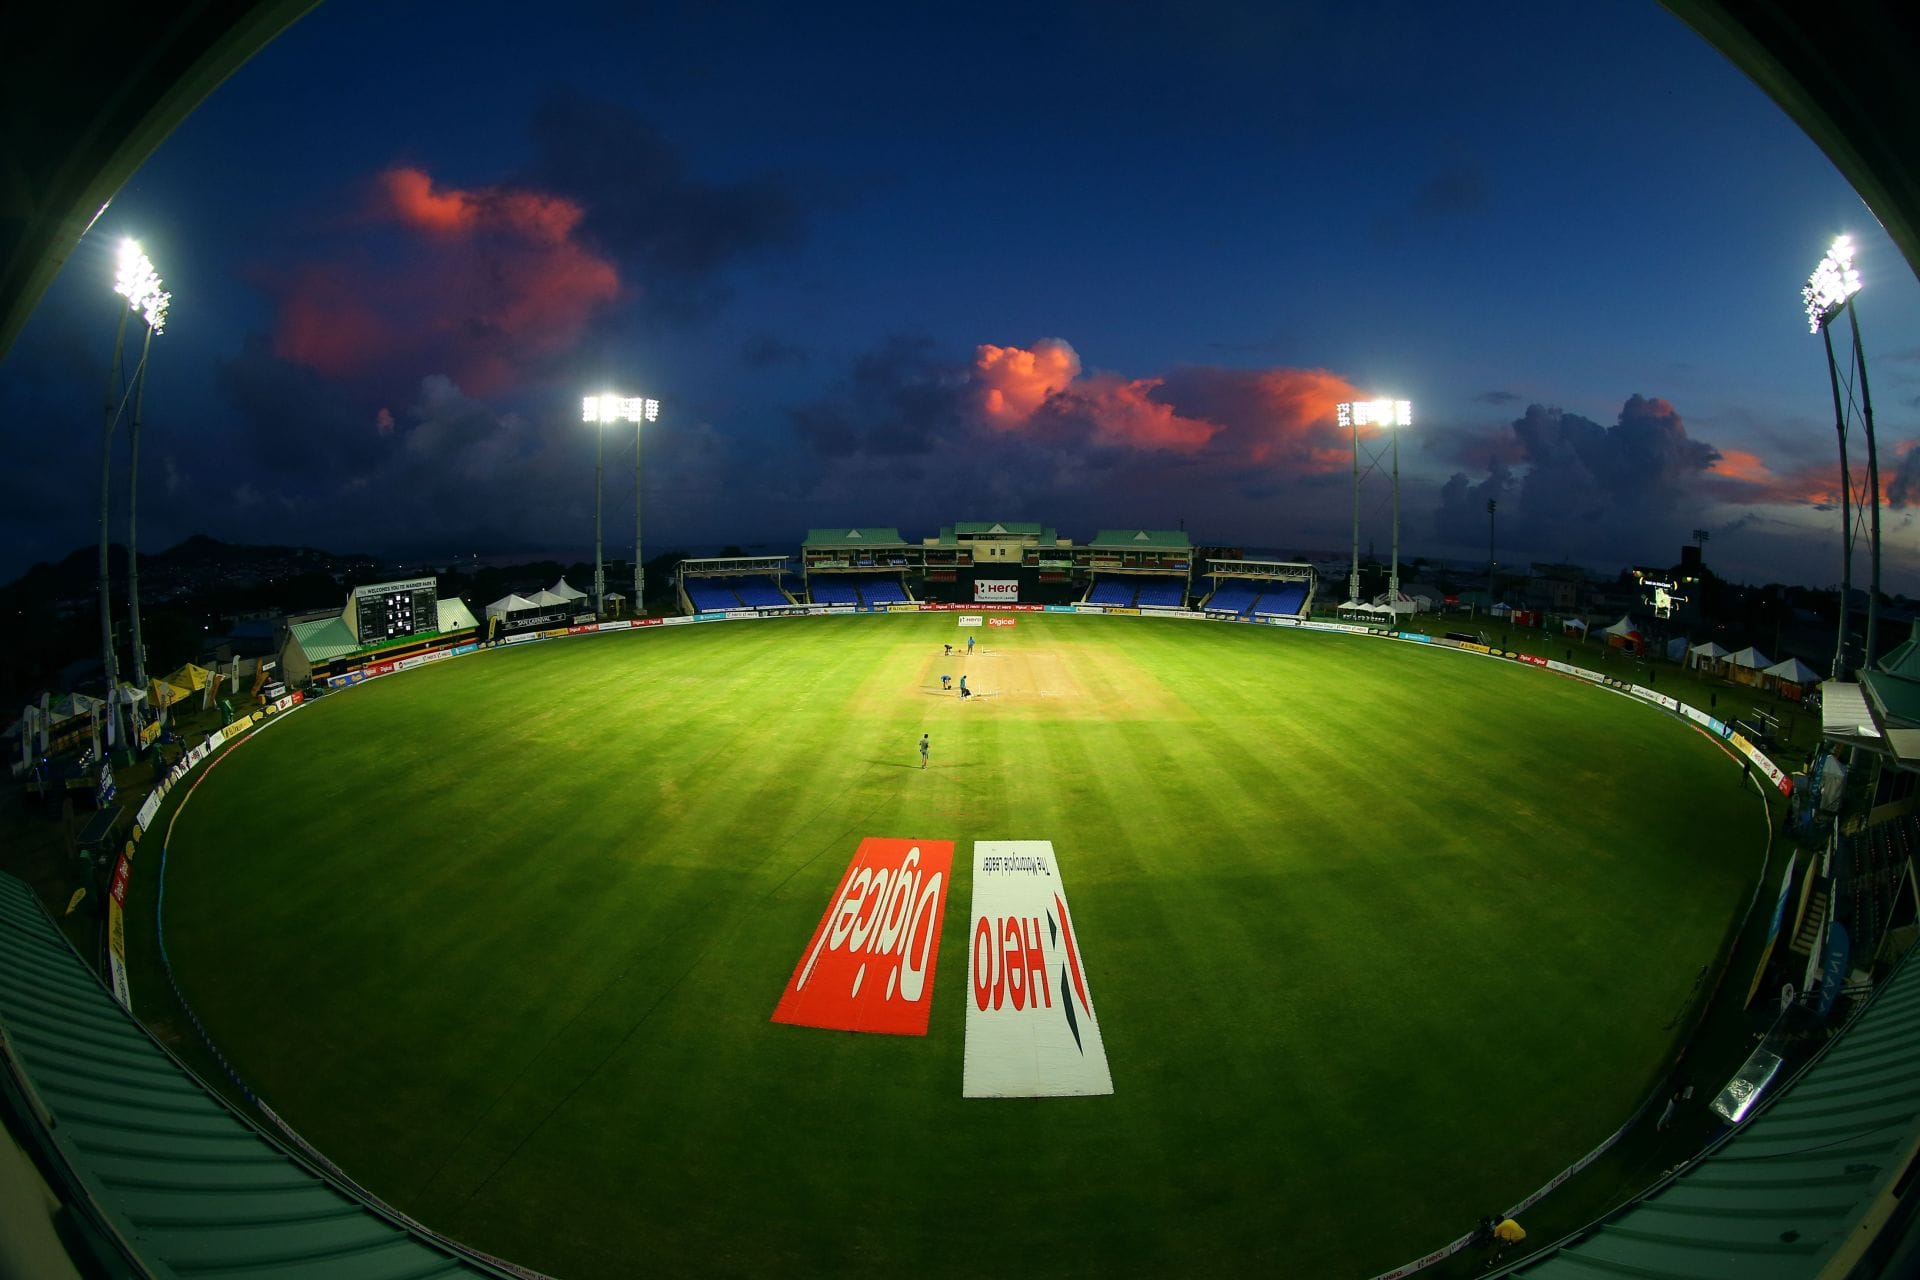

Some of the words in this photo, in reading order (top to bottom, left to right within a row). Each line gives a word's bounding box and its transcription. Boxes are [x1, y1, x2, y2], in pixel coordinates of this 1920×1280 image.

[988, 584, 1021, 593] Hero
[989, 618, 1015, 626] Digicel
[983, 856, 1004, 876] Leader
[1003, 851, 1038, 876] Motorcycle
[796, 846, 943, 1002] Digicel
[973, 915, 1052, 1012] Hero
